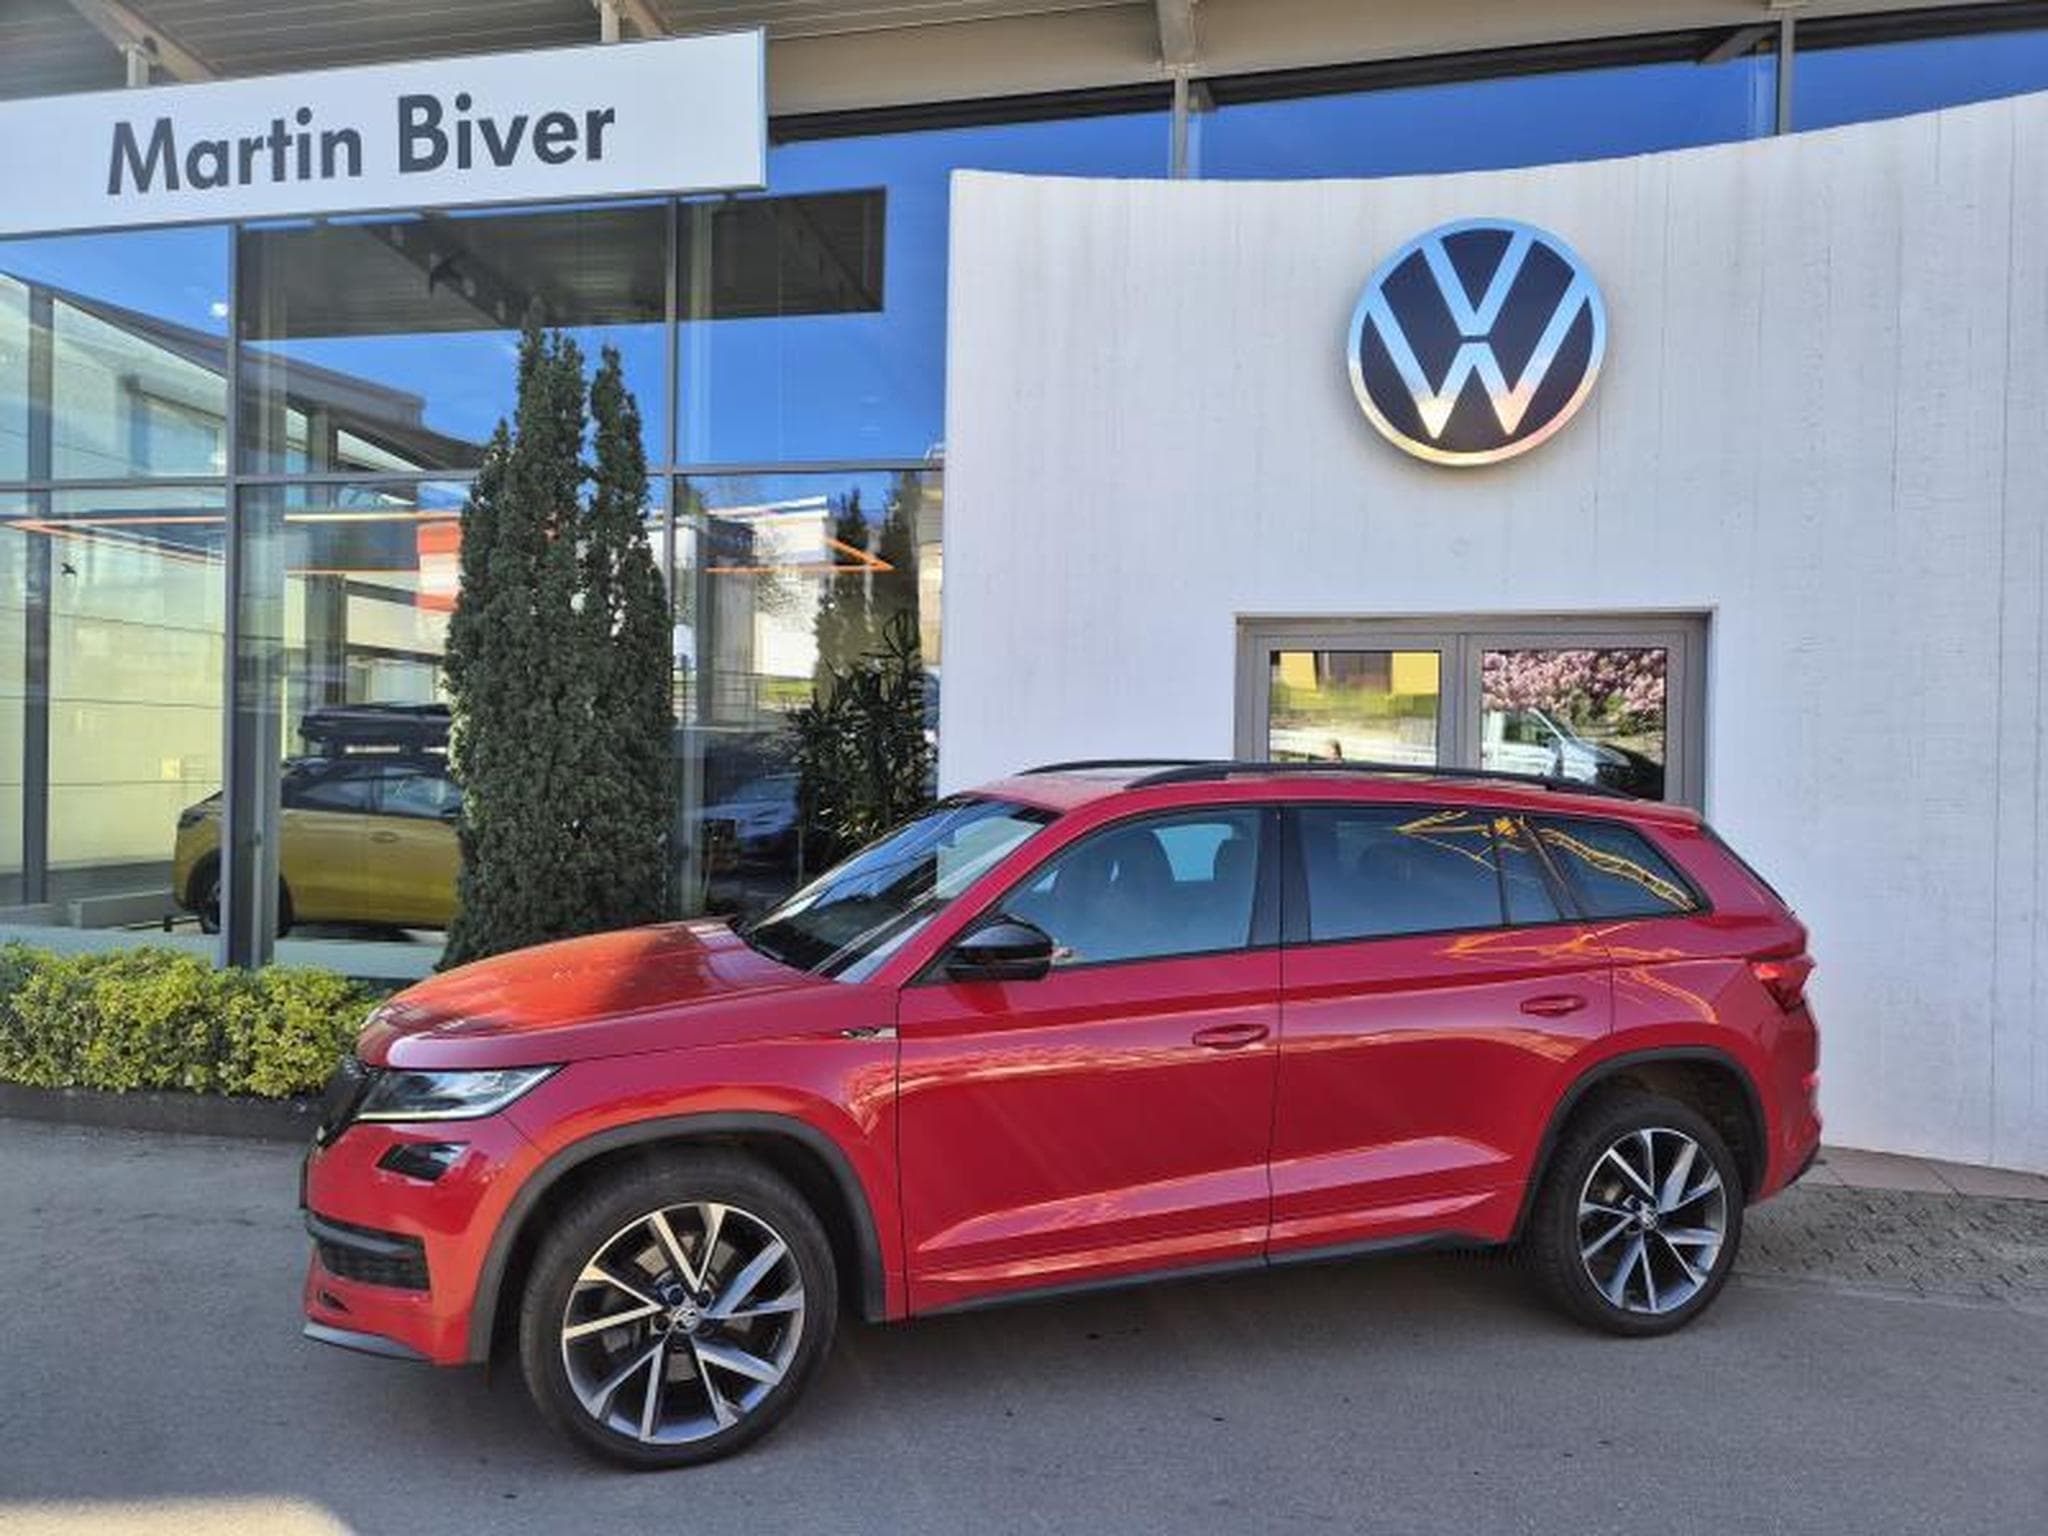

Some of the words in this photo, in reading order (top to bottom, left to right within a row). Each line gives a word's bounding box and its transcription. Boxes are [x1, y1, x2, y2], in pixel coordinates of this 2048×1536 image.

[107, 107, 363, 197] Martin
[397, 93, 616, 174] Biver
[1358, 222, 1600, 446] VW
